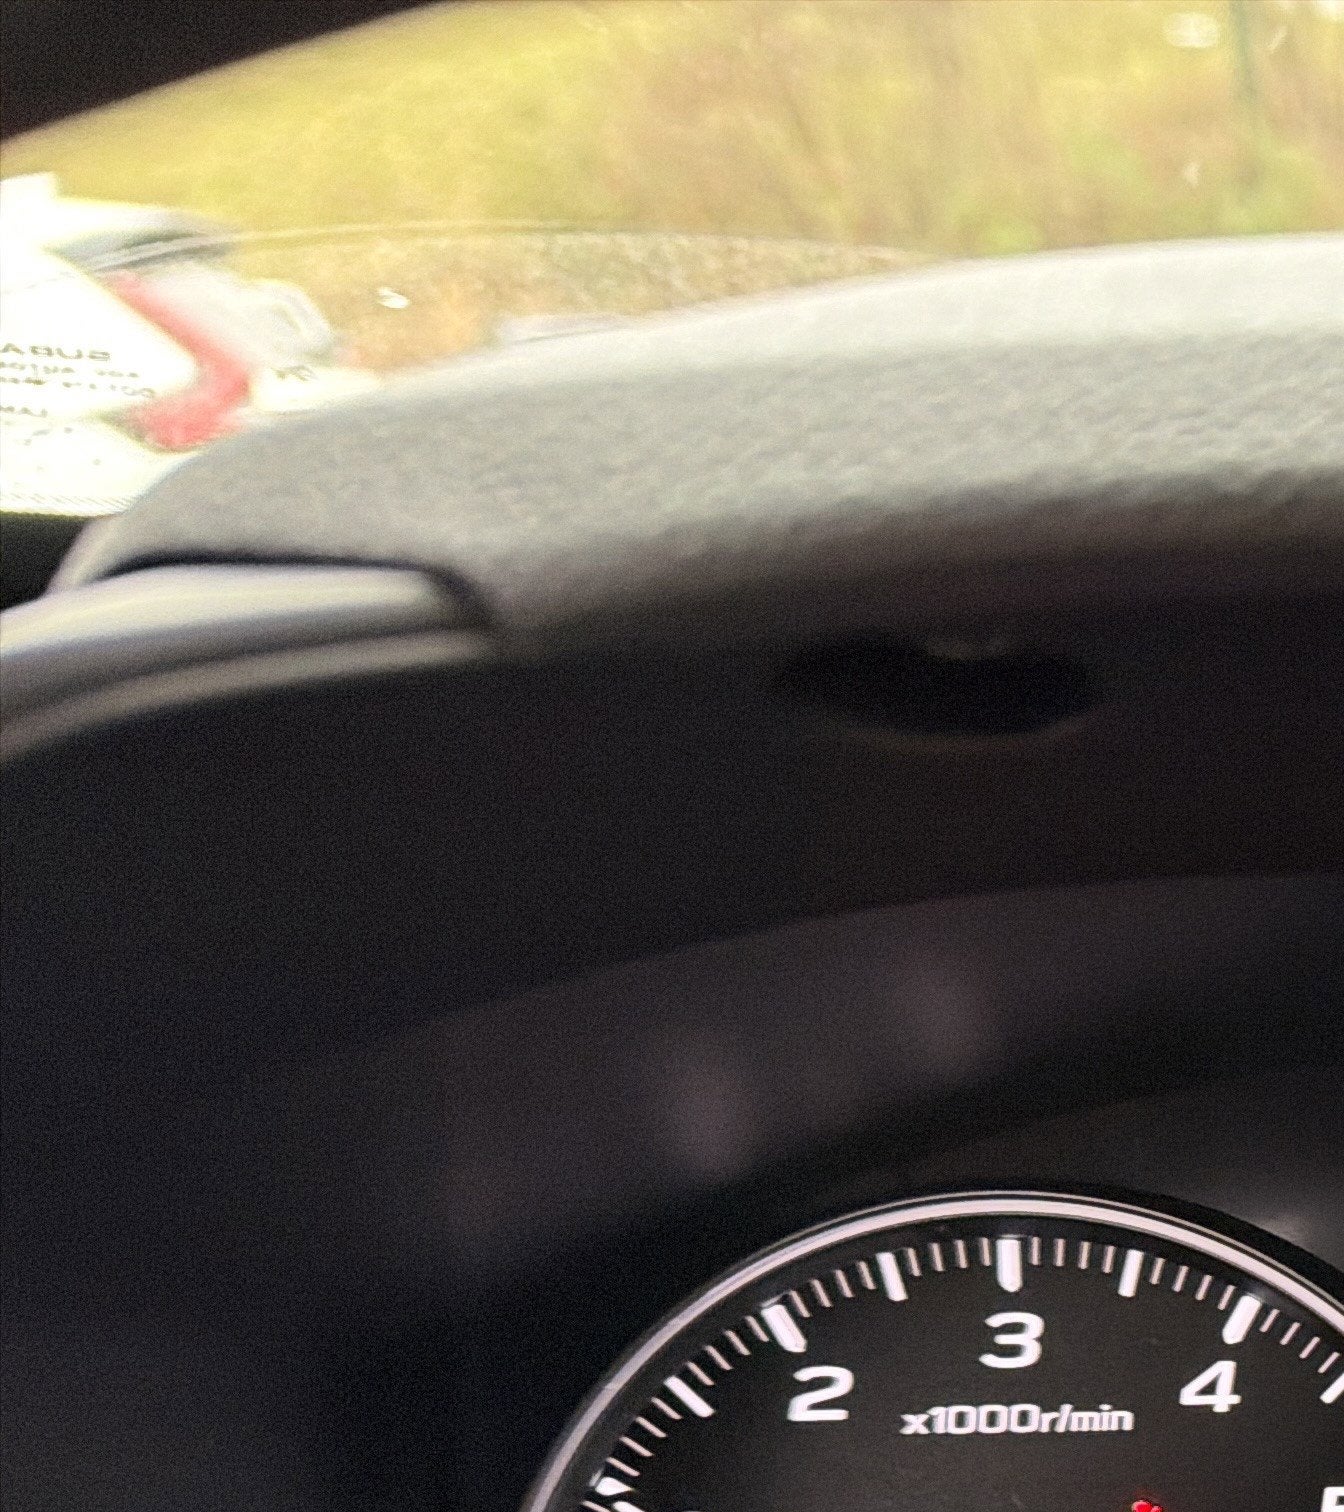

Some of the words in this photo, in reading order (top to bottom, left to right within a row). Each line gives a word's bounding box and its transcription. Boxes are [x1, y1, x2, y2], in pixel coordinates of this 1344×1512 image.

[977, 1310, 1046, 1370] 3
[786, 1364, 856, 1423] 2
[1177, 1359, 1243, 1414] 4
[898, 1402, 1136, 1436] x1000r/min
